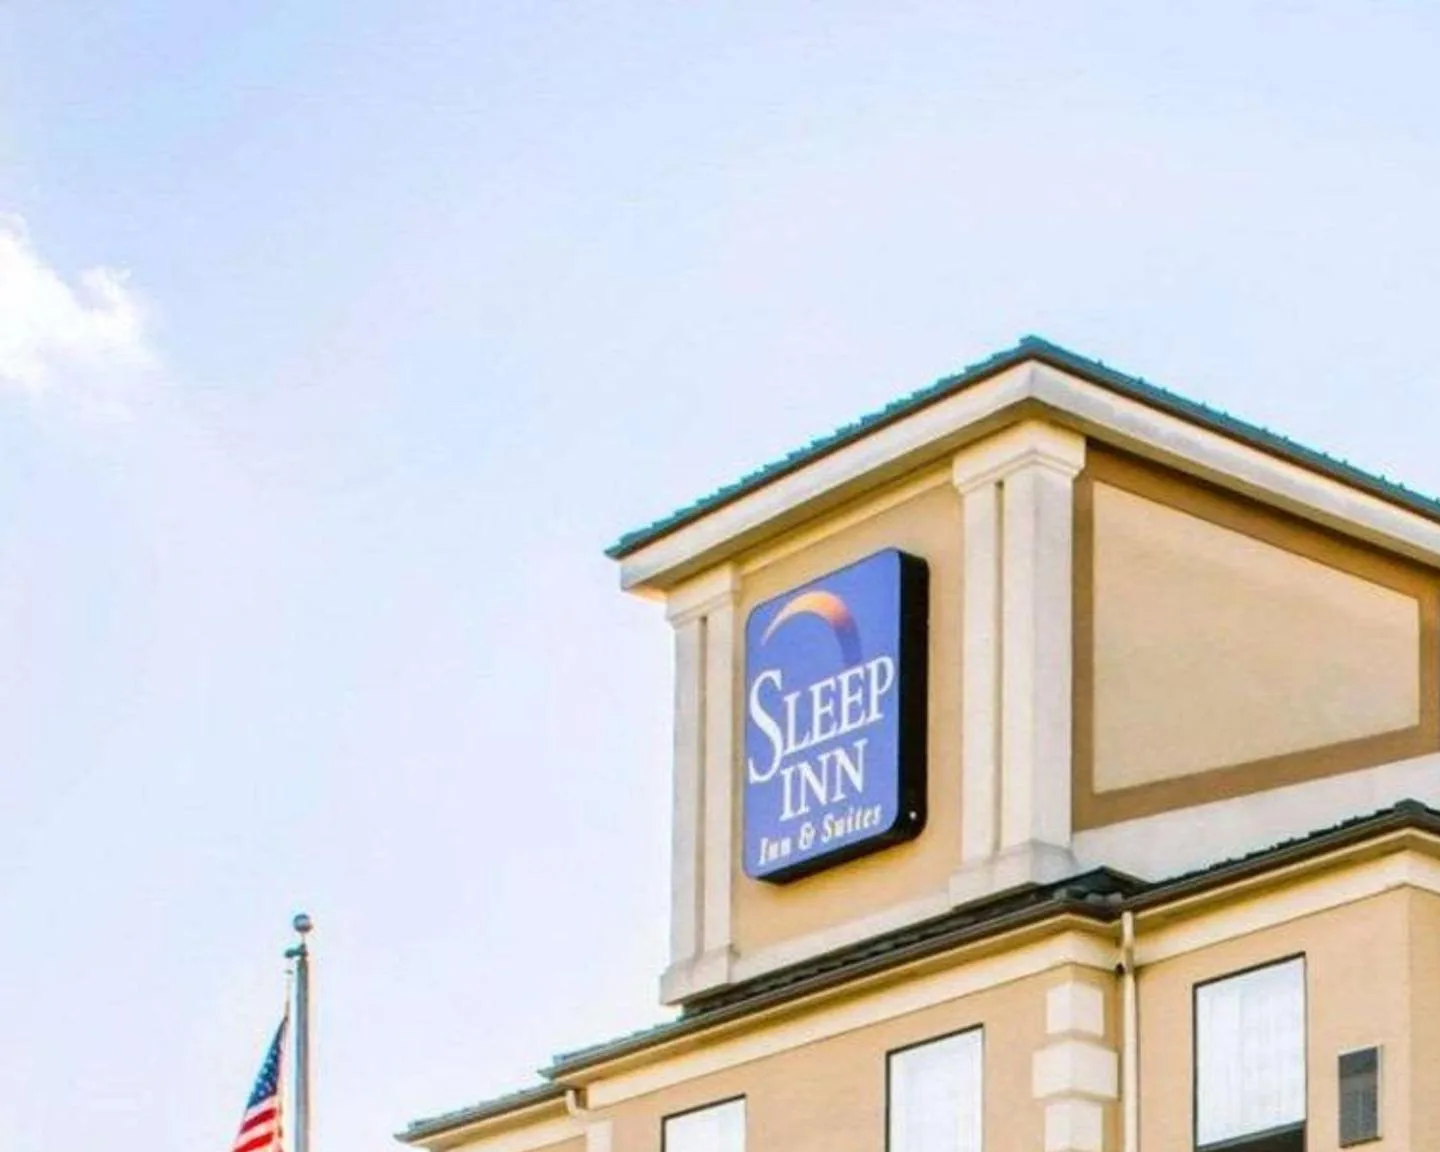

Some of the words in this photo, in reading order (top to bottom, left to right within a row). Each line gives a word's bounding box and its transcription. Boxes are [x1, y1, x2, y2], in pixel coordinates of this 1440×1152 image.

[748, 655, 895, 783] SLEEP
[779, 739, 868, 822] INN
[760, 838, 791, 865] Inn
[799, 822, 816, 851] &
[822, 803, 882, 842] Suites
